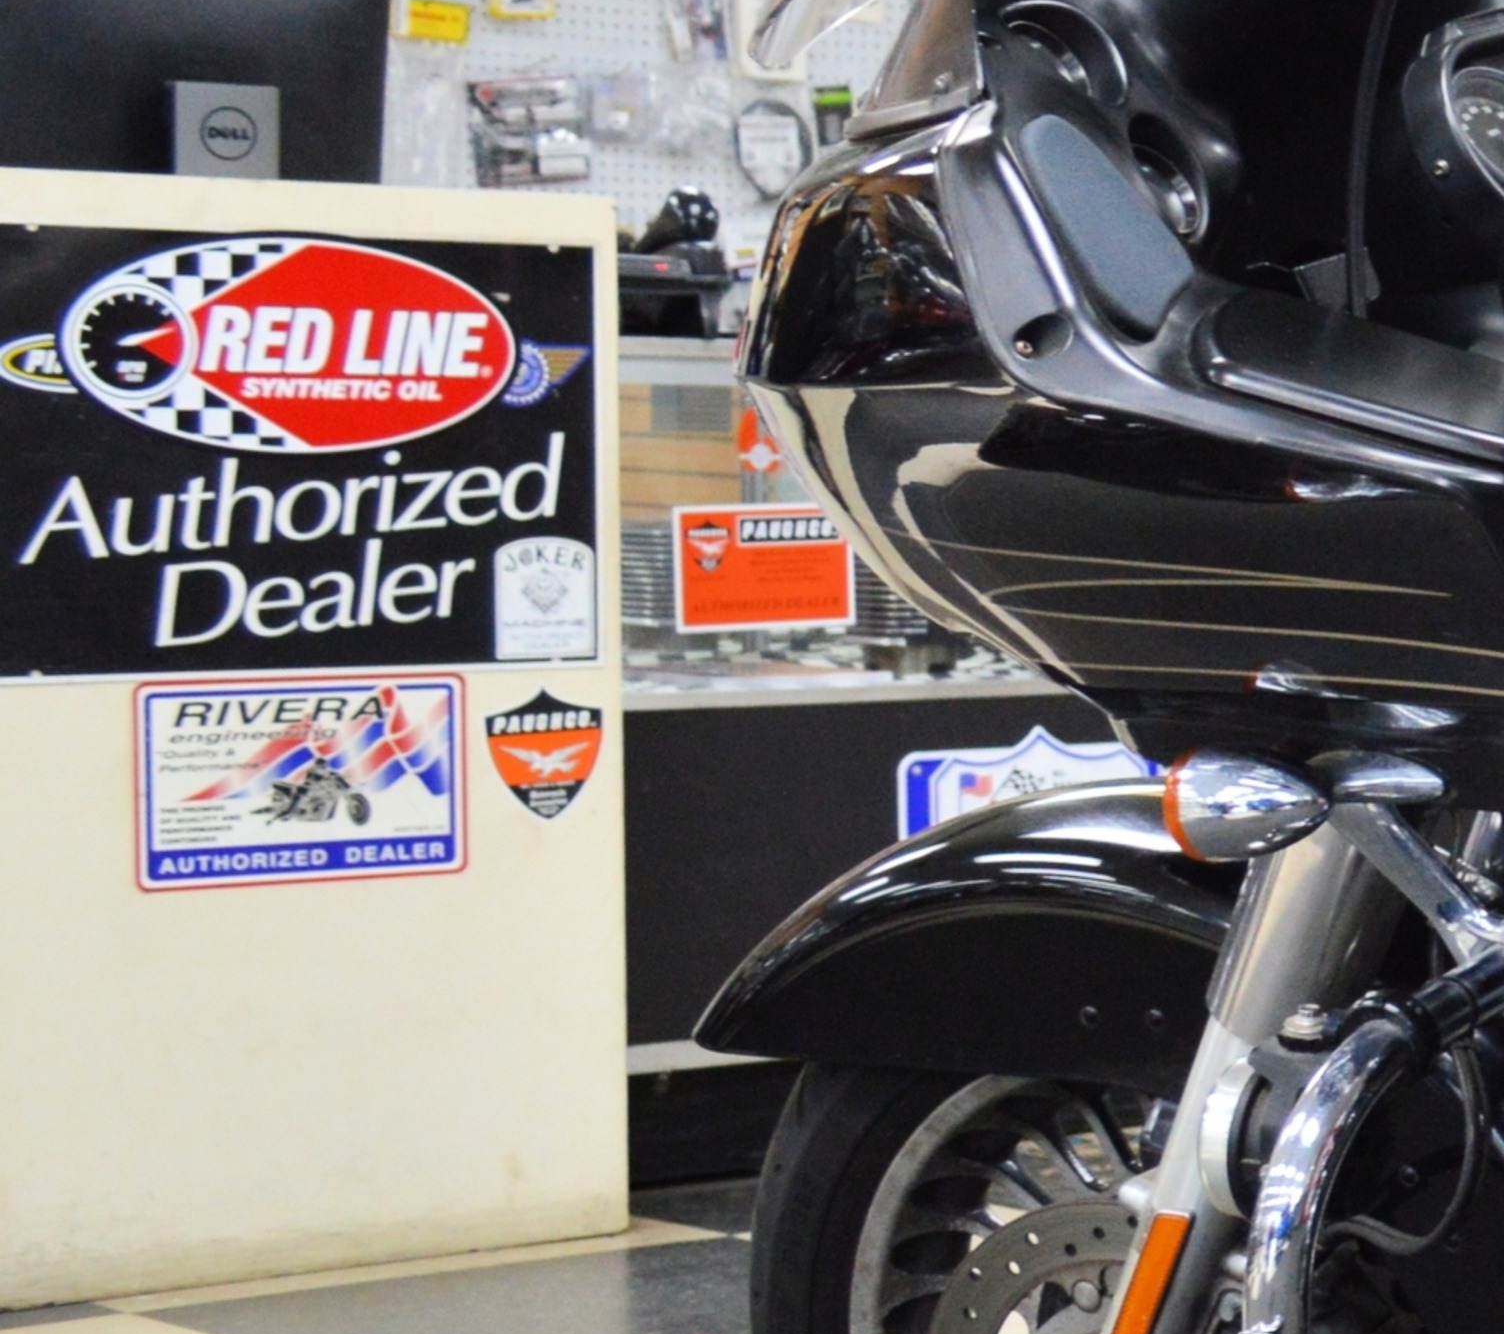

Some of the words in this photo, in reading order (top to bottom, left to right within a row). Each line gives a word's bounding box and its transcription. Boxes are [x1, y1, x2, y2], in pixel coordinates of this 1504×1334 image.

[208, 127, 250, 140] DELL
[201, 305, 334, 373] RED
[344, 308, 489, 377] LINE
[241, 377, 390, 400] SYNTHETIC
[398, 380, 442, 400] OIL
[18, 432, 566, 565] Authorized
[154, 539, 476, 647] Dealer
[174, 696, 386, 728] RIVERA
[168, 726, 338, 745] engineering
[158, 848, 328, 875] AUTHORIZED
[345, 841, 445, 864] DEALER
